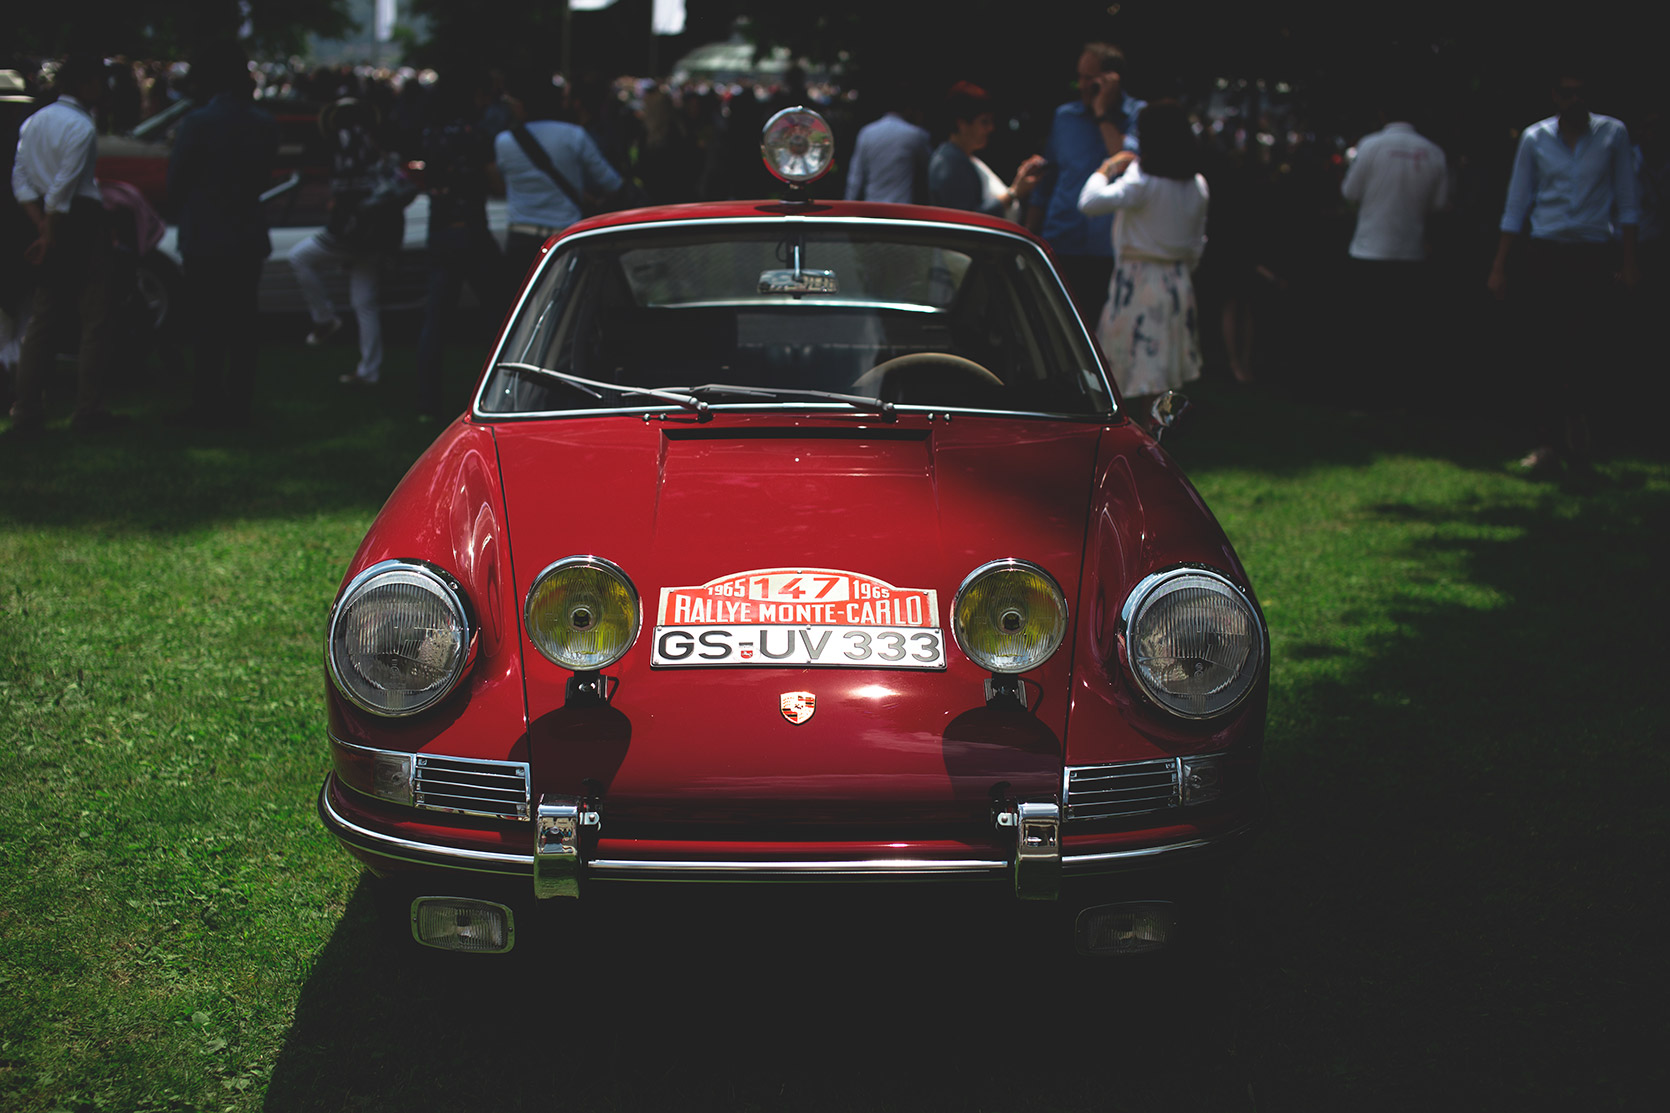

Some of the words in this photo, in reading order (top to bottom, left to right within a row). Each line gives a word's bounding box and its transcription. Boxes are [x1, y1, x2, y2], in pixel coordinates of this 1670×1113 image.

[708, 579, 746, 597] 1965
[754, 577, 840, 599] 147
[853, 579, 890, 599] 1965
[674, 594, 752, 623] RALLYE
[759, 595, 923, 625] MONTE-CARLO
[843, 630, 940, 662] 333
